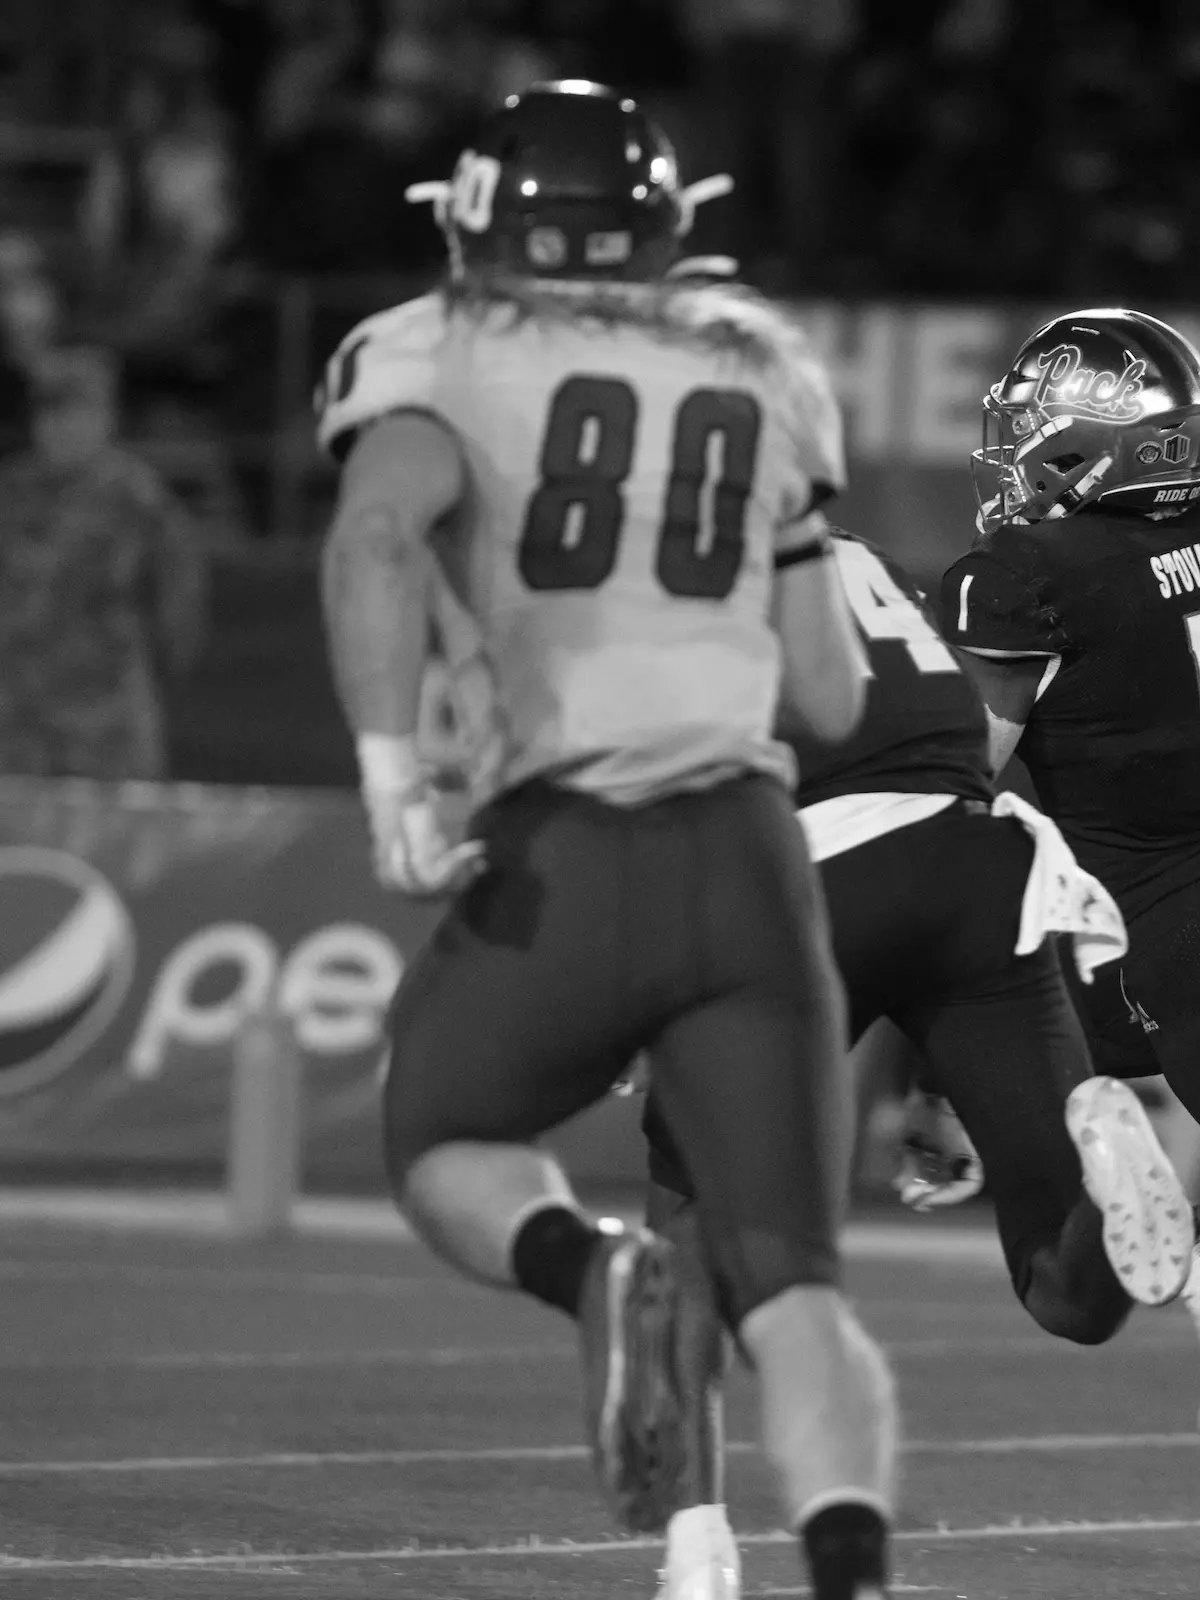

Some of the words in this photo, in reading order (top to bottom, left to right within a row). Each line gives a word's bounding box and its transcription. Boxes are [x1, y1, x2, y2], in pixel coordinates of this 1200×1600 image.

[1035, 344, 1146, 420] Pack
[517, 373, 761, 599] 80
[1153, 488, 1189, 502] RIDE
